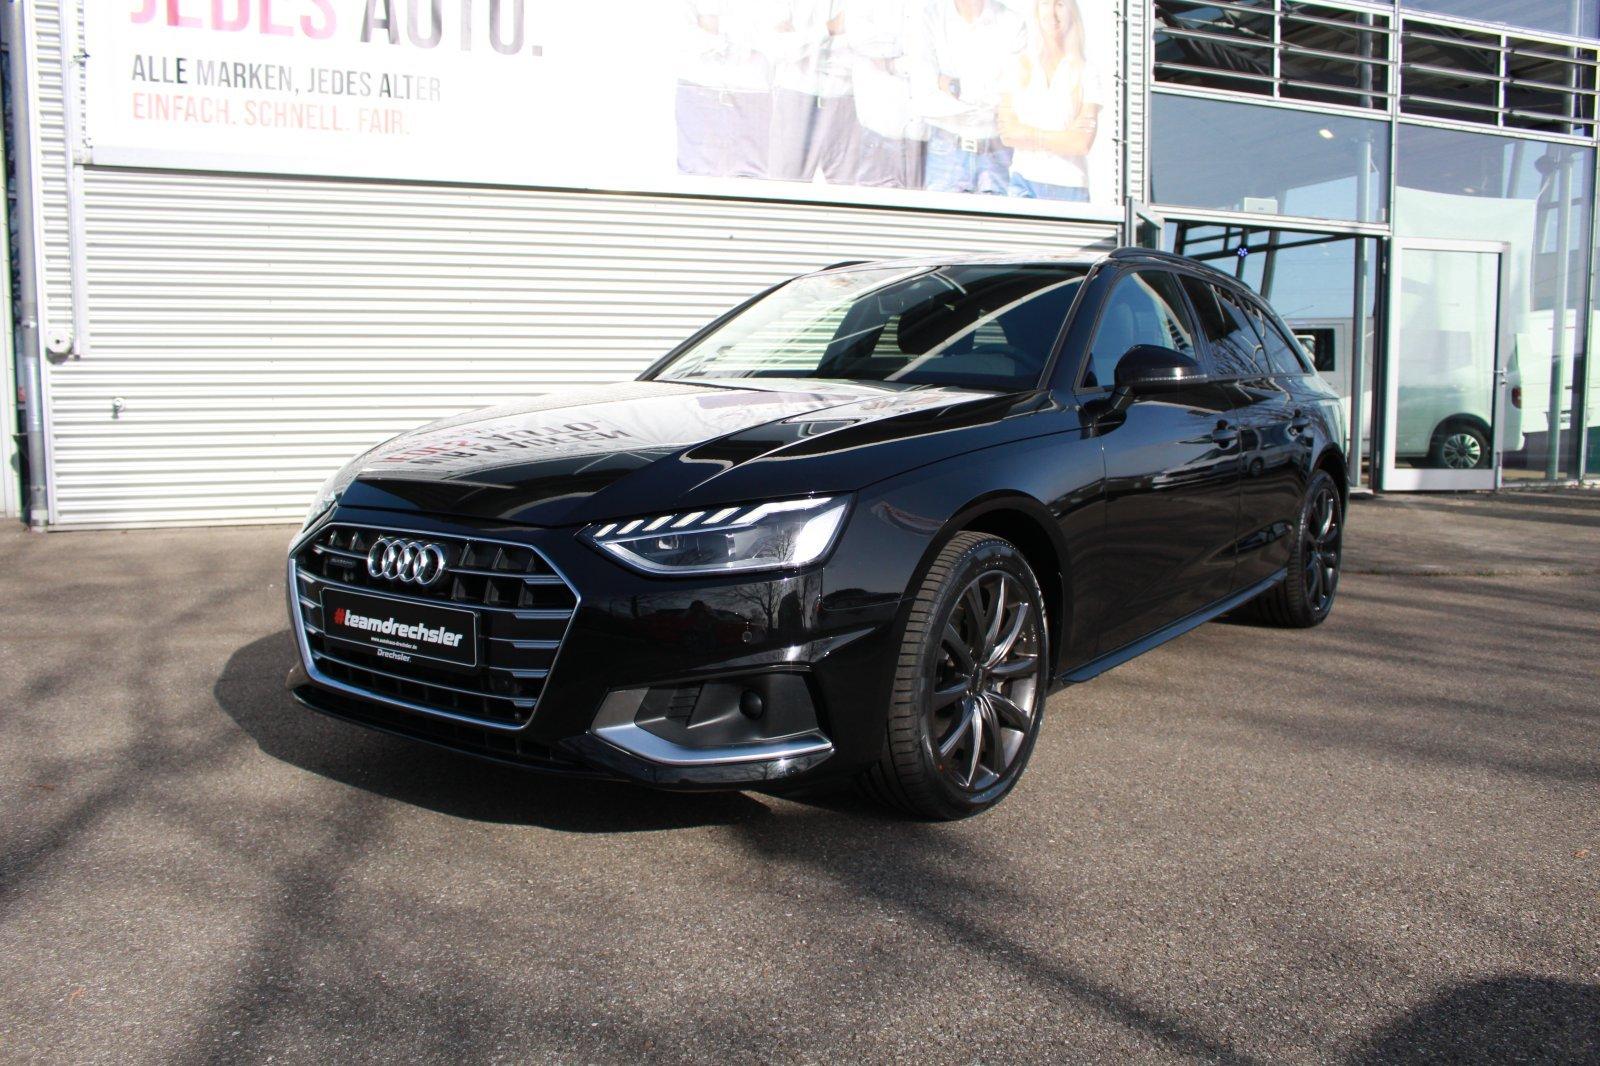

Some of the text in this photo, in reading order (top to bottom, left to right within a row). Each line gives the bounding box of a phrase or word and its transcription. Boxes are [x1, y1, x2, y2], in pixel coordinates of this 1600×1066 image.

[131, 53, 441, 102] ALLE MARKEN, JEDES ALTER
[132, 92, 411, 135] EINFACH. SCHNELL. FAIR.
[334, 607, 463, 647] #teamdrechsler
